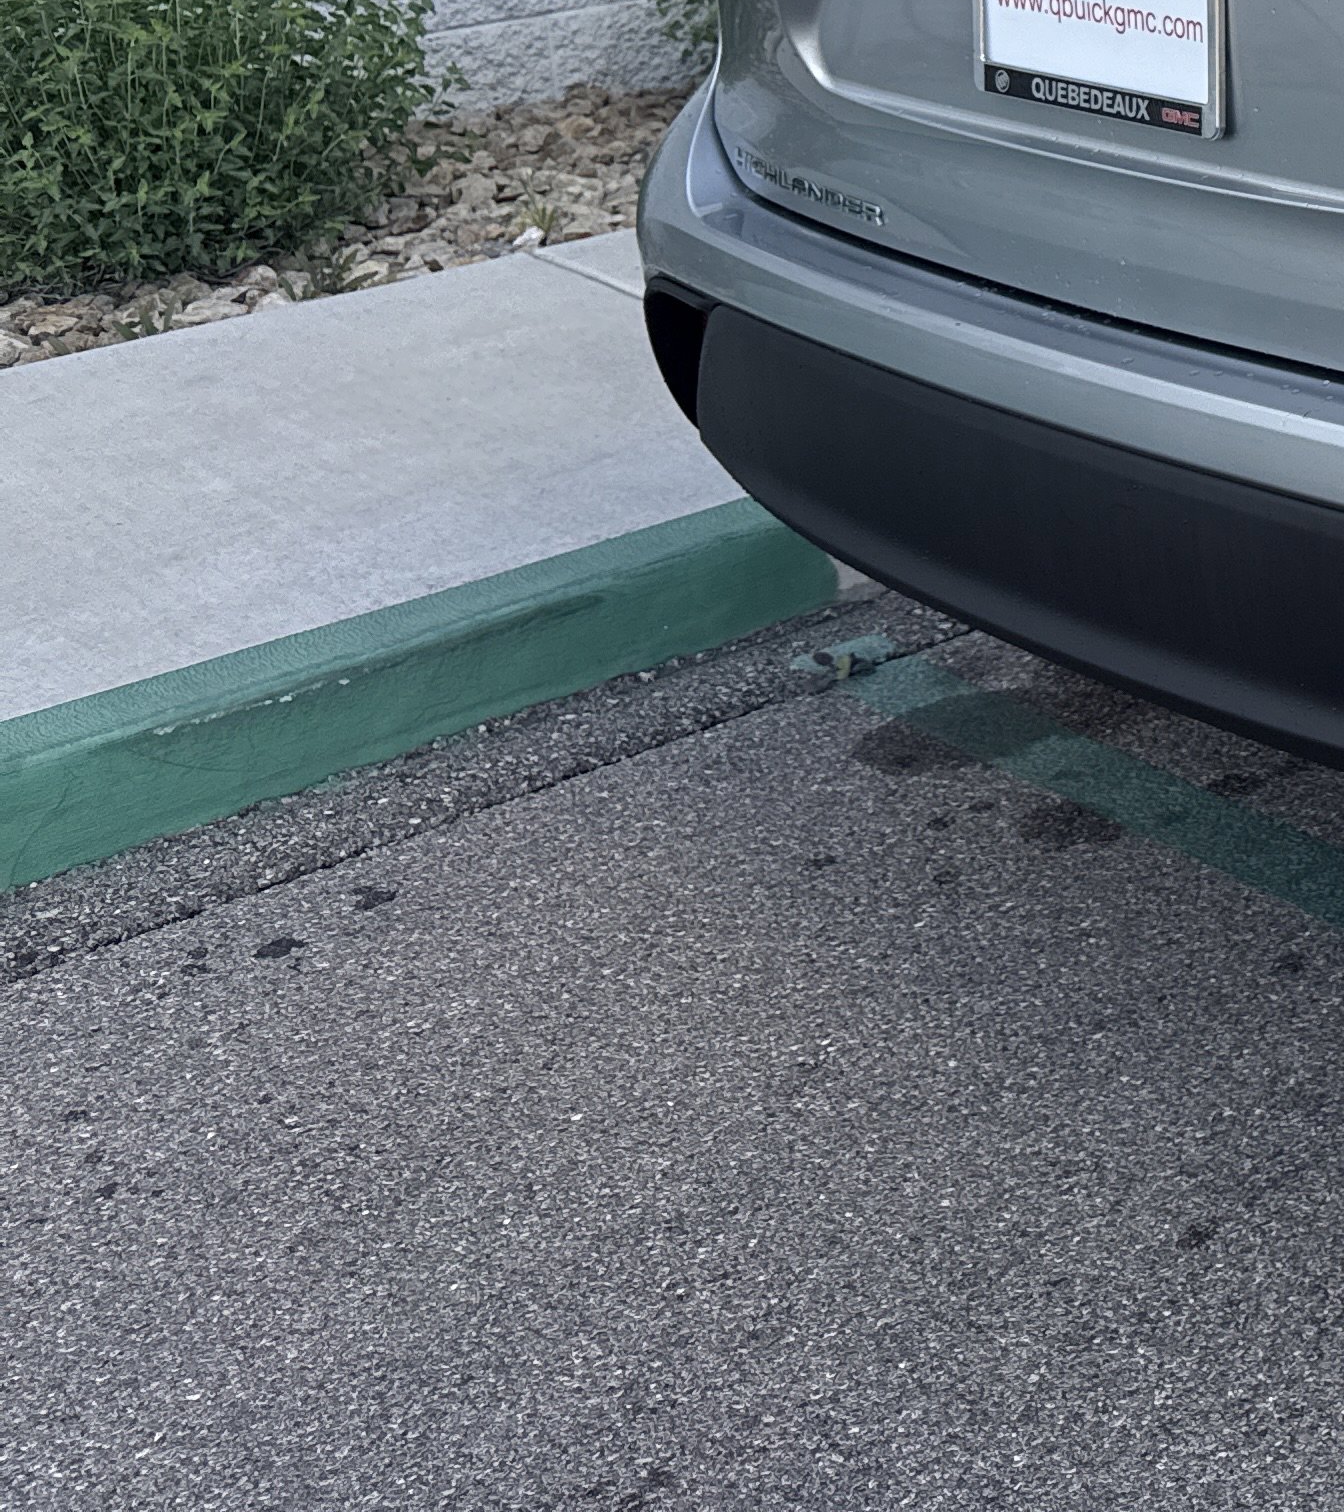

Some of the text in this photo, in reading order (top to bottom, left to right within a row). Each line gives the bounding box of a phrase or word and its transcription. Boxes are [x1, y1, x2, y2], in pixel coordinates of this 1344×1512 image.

[1031, 77, 1200, 128] QUEBEDEAUX GMC
[734, 146, 888, 227] HIGHLANDER
